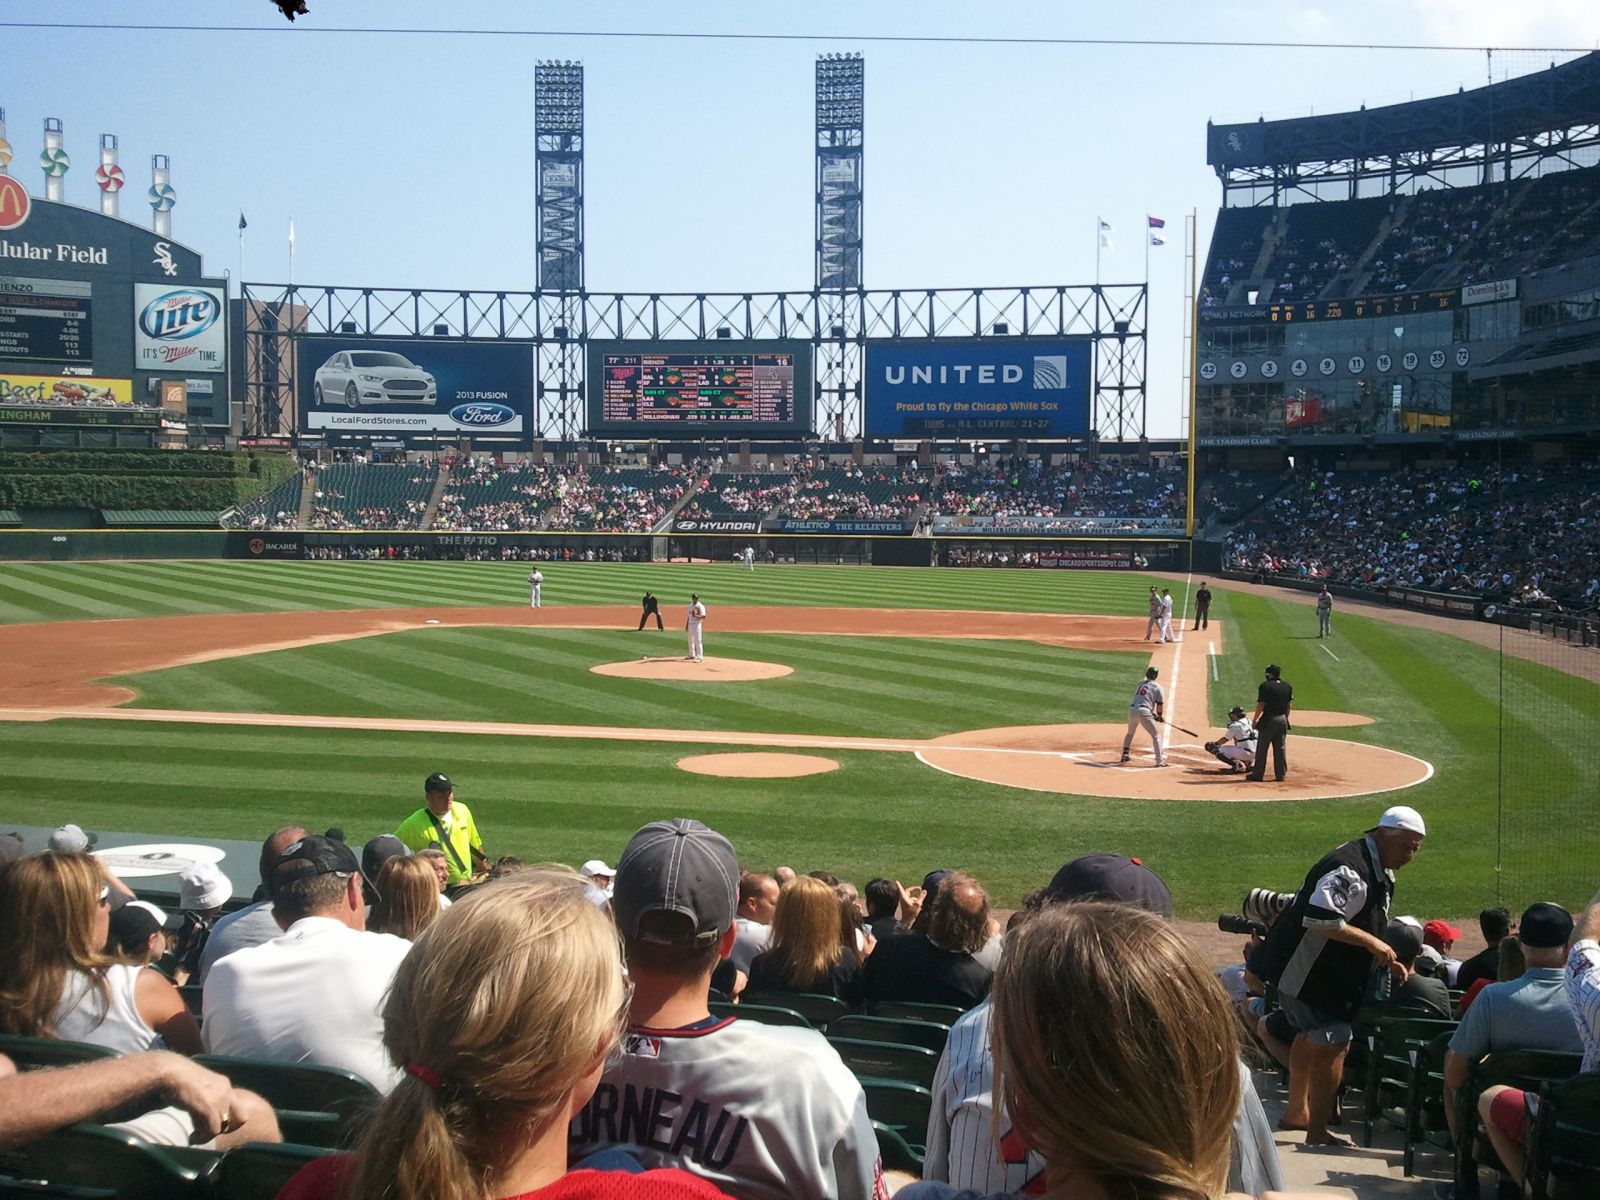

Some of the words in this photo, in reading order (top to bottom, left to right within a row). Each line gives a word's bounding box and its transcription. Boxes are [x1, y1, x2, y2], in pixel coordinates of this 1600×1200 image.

[0, 240, 52, 260] lular
[56, 244, 108, 264] Field
[152, 300, 209, 339] Lite
[1306, 311, 1315, 319] 16
[143, 348, 158, 360] IT'S
[160, 346, 198, 364] Miller
[199, 350, 216, 362] TIME
[1406, 355, 1414, 364] 19
[1432, 354, 1443, 362] 35
[1458, 351, 1467, 360] 72
[1296, 362, 1302, 370] 4
[1352, 360, 1361, 368] 11
[1379, 358, 1388, 366] 16
[1236, 364, 1242, 372] 2
[886, 365, 1023, 384] UNITED
[456, 391, 475, 399] 2013
[896, 402, 924, 411] Proud
[927, 403, 936, 411] to
[938, 402, 951, 412] fly
[954, 402, 969, 411] the
[972, 402, 1008, 412] Chicago
[1010, 402, 1038, 410] White
[1040, 402, 1058, 410] Sox
[0, 410, 51, 421] INGHAM
[462, 404, 502, 424] Ford
[332, 416, 427, 426] LocalFordStores.com
[700, 522, 756, 530] HYUNDAI
[785, 520, 830, 529] ATHLETICO
[438, 536, 460, 544] THE
[464, 536, 497, 545] PATIO
